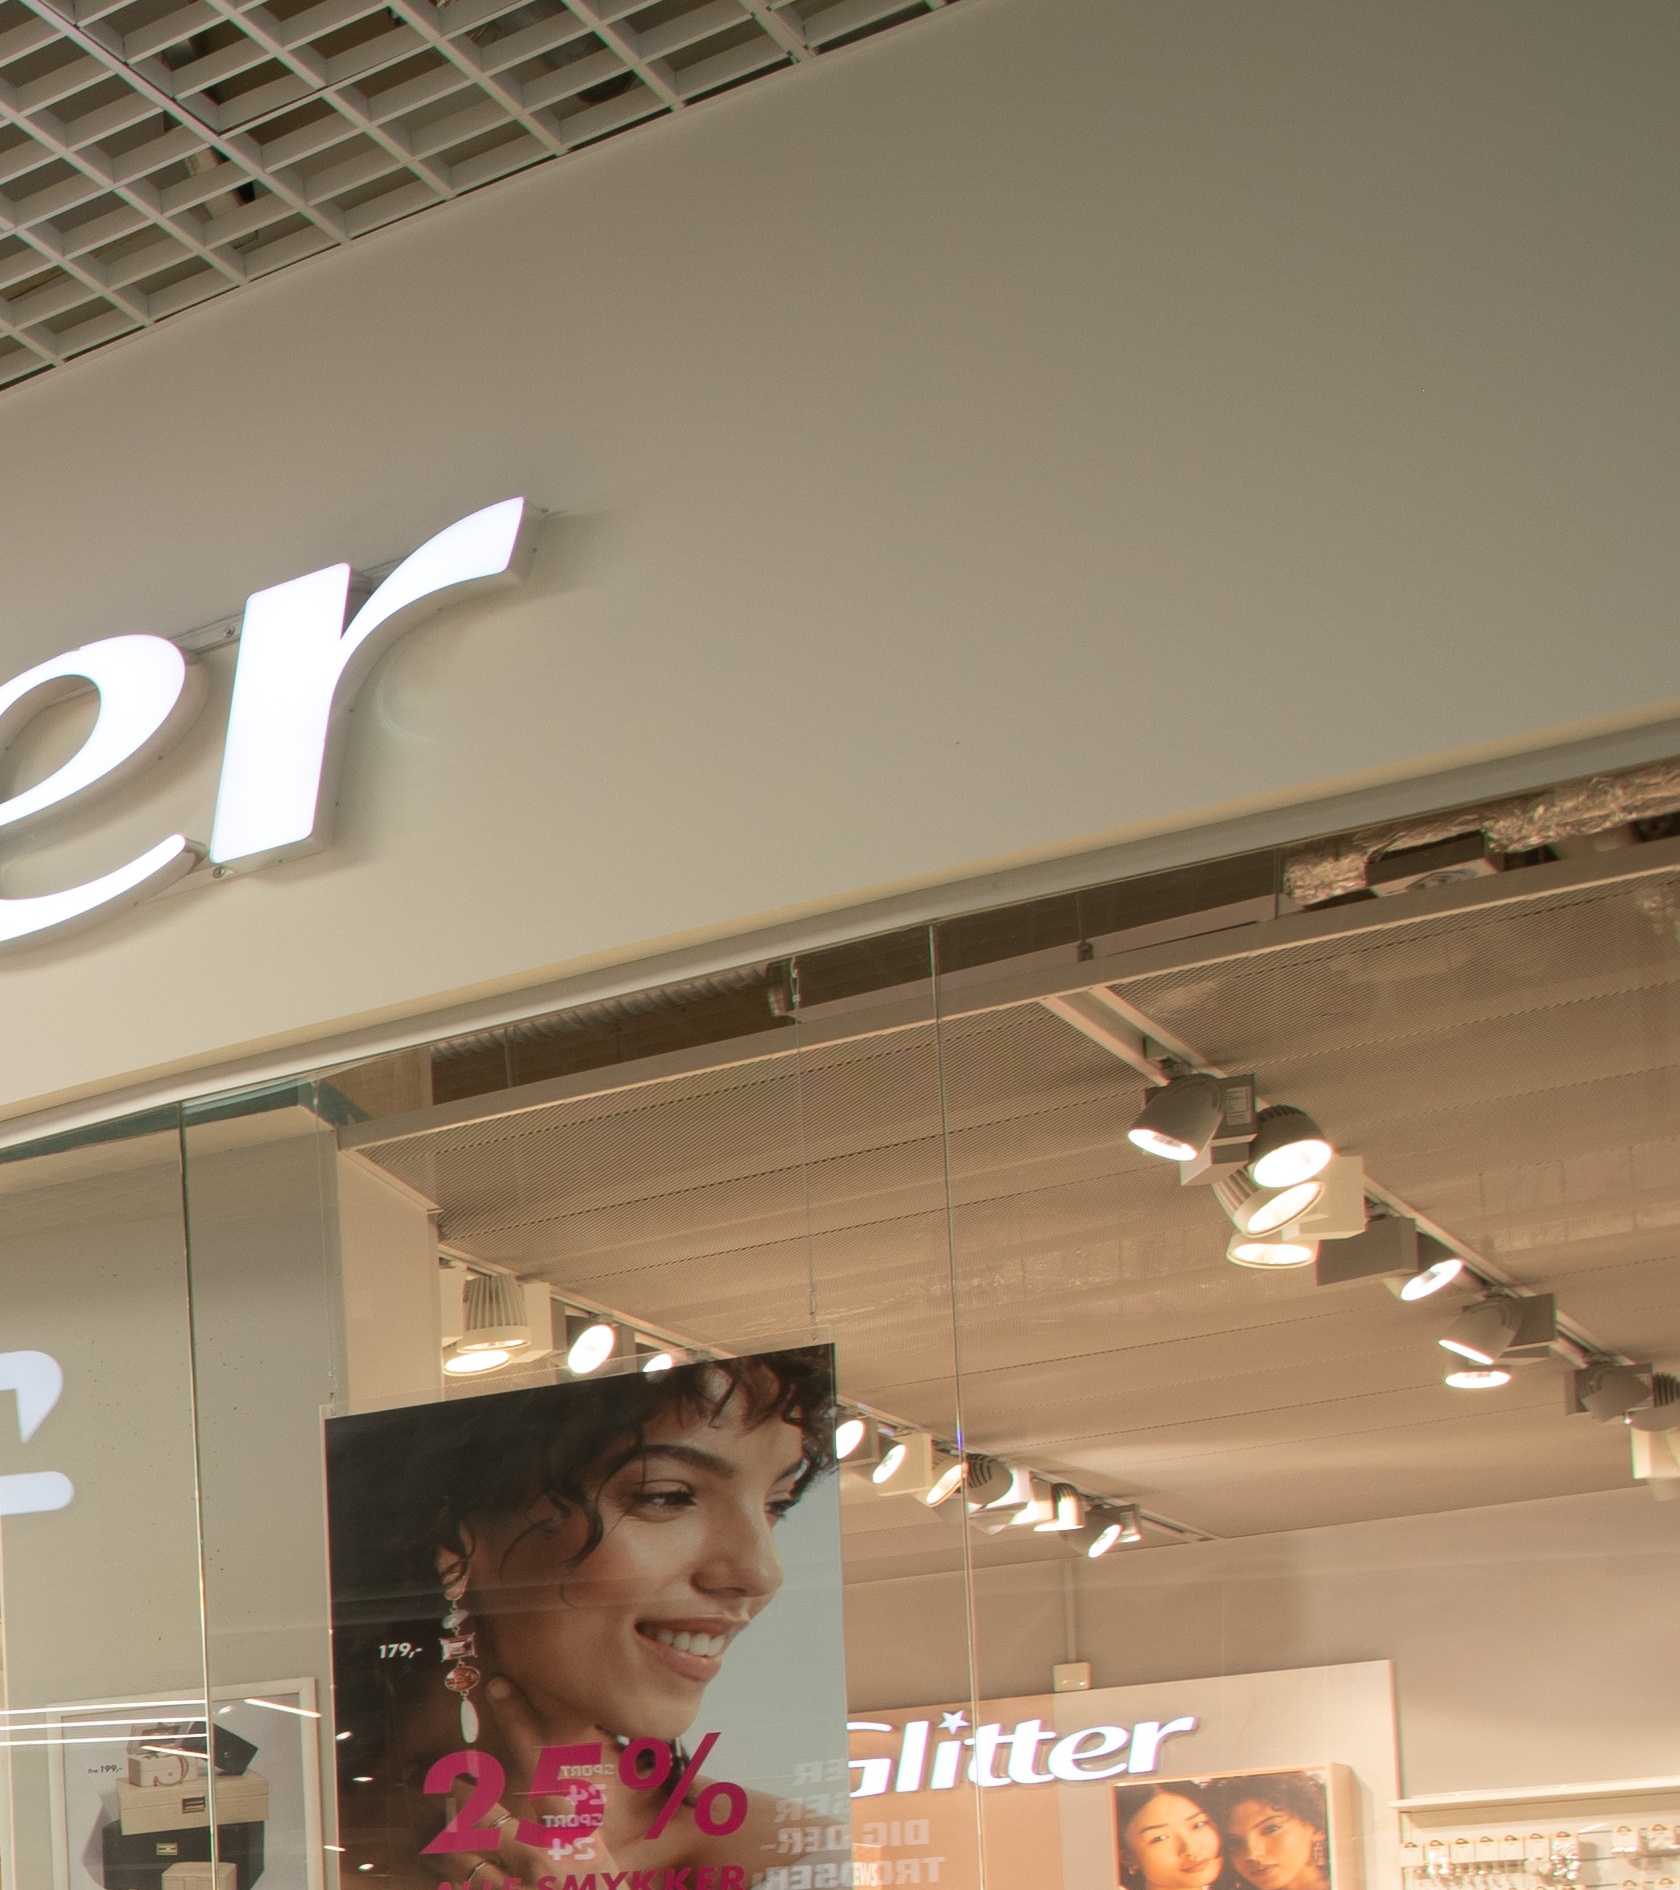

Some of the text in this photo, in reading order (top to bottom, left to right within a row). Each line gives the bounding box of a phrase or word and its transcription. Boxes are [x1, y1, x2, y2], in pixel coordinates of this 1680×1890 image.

[379, 1641, 422, 1660] 179,-
[845, 1711, 1198, 1798] Glitter
[100, 1765, 123, 1773] 199,-
[420, 1732, 748, 1855] 25%
[853, 1862, 878, 1887] EWS
